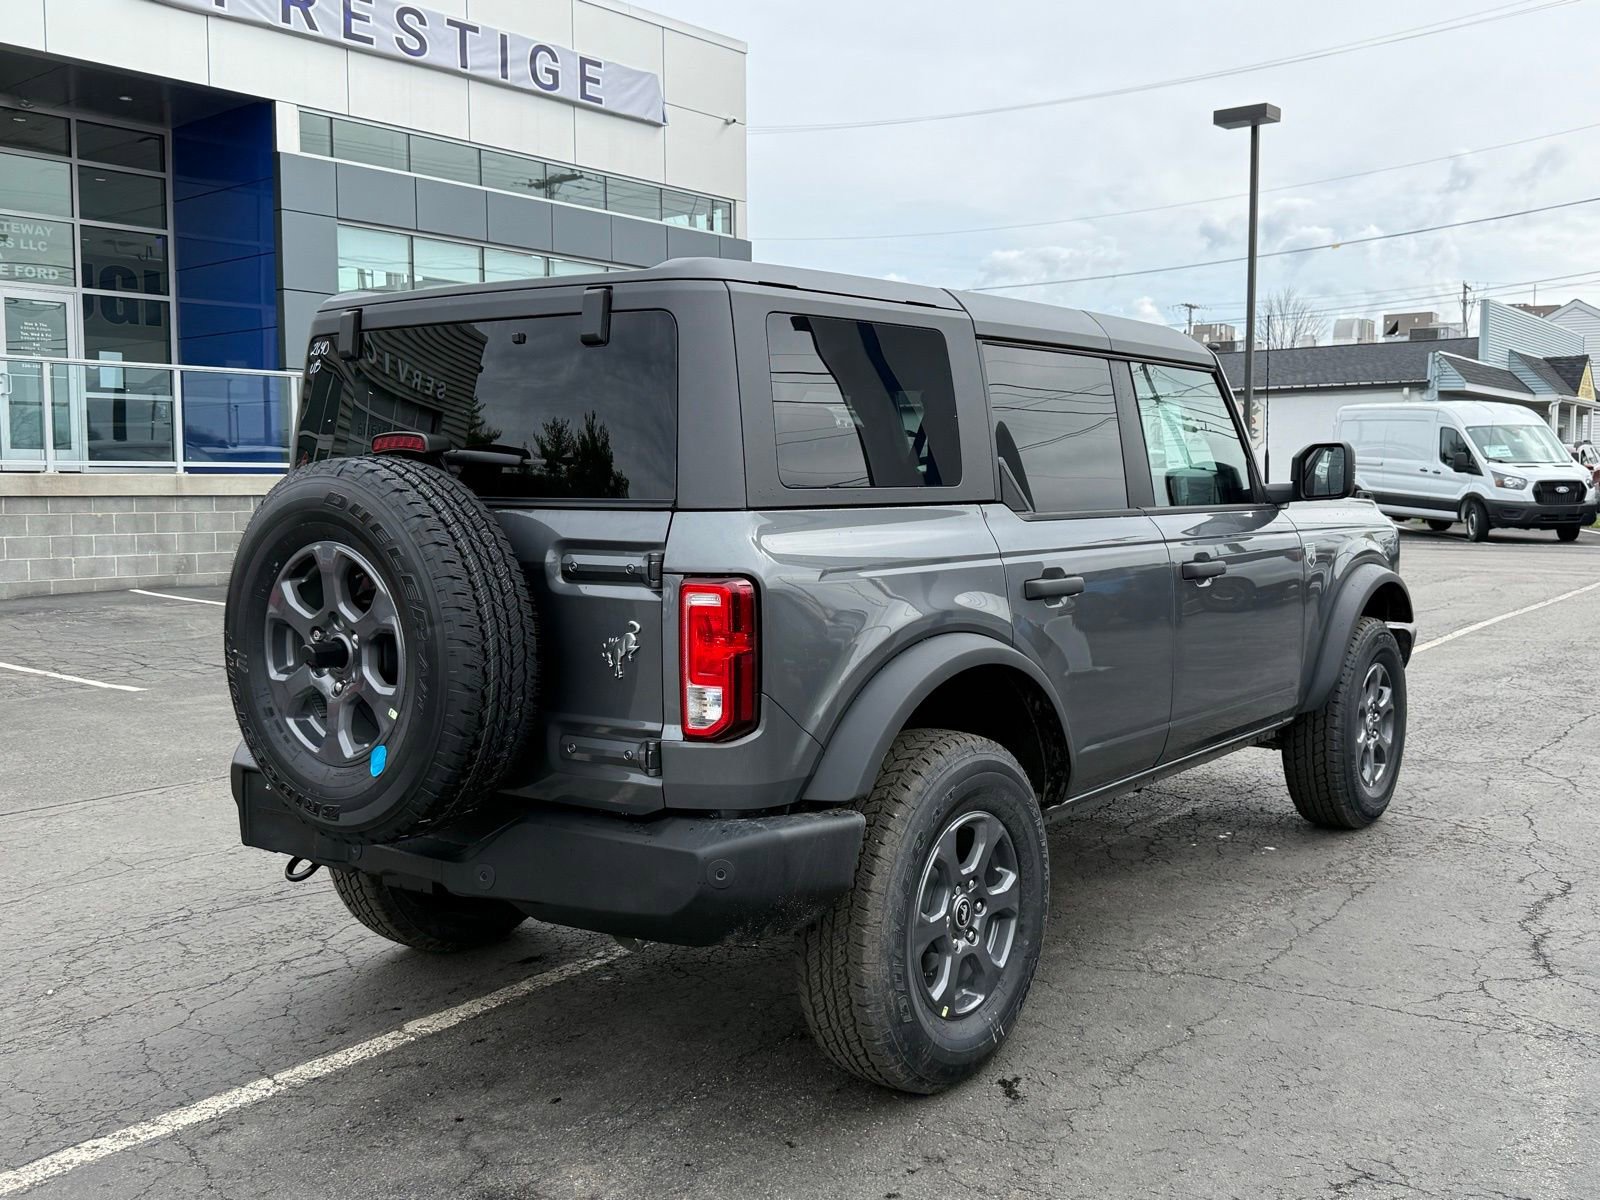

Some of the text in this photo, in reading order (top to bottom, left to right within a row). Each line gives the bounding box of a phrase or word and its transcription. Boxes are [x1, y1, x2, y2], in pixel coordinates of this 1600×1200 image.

[214, 0, 603, 105] RESTIGE
[0, 222, 53, 237] TEWAY
[20, 239, 48, 252] LLC
[15, 264, 59, 280] FORD
[324, 491, 430, 642] DUELER
[891, 830, 927, 1023] DUELER
